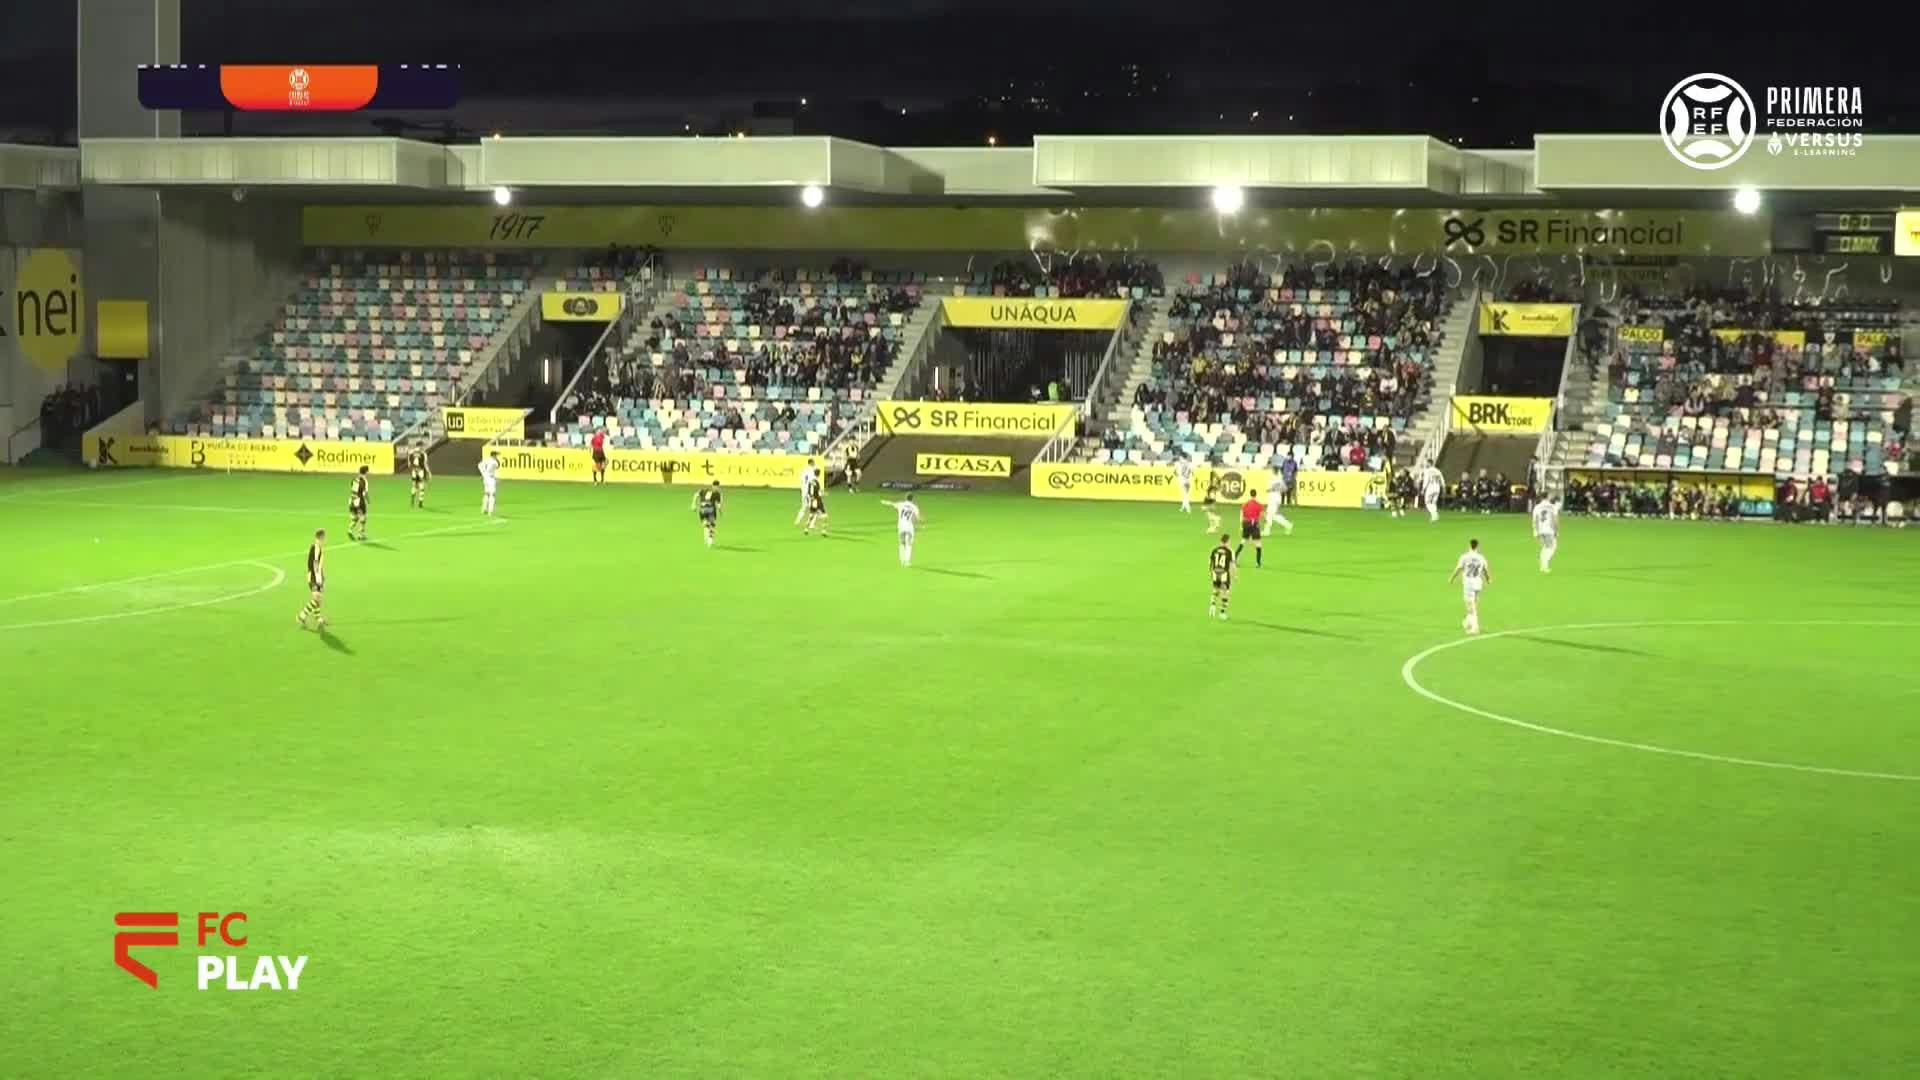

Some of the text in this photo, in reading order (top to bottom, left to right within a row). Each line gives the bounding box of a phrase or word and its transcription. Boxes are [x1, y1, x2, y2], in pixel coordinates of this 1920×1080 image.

[490, 214, 545, 240] 1917
[1498, 219, 1683, 245] SR Financial
[0, 273, 77, 337] nei
[448, 416, 463, 429] UD
[930, 409, 1056, 430] SR Financial
[1469, 403, 1509, 425] BRK
[317, 448, 377, 464] Radimer
[919, 456, 1007, 473] JICASA
[1214, 553, 1226, 568] 14
